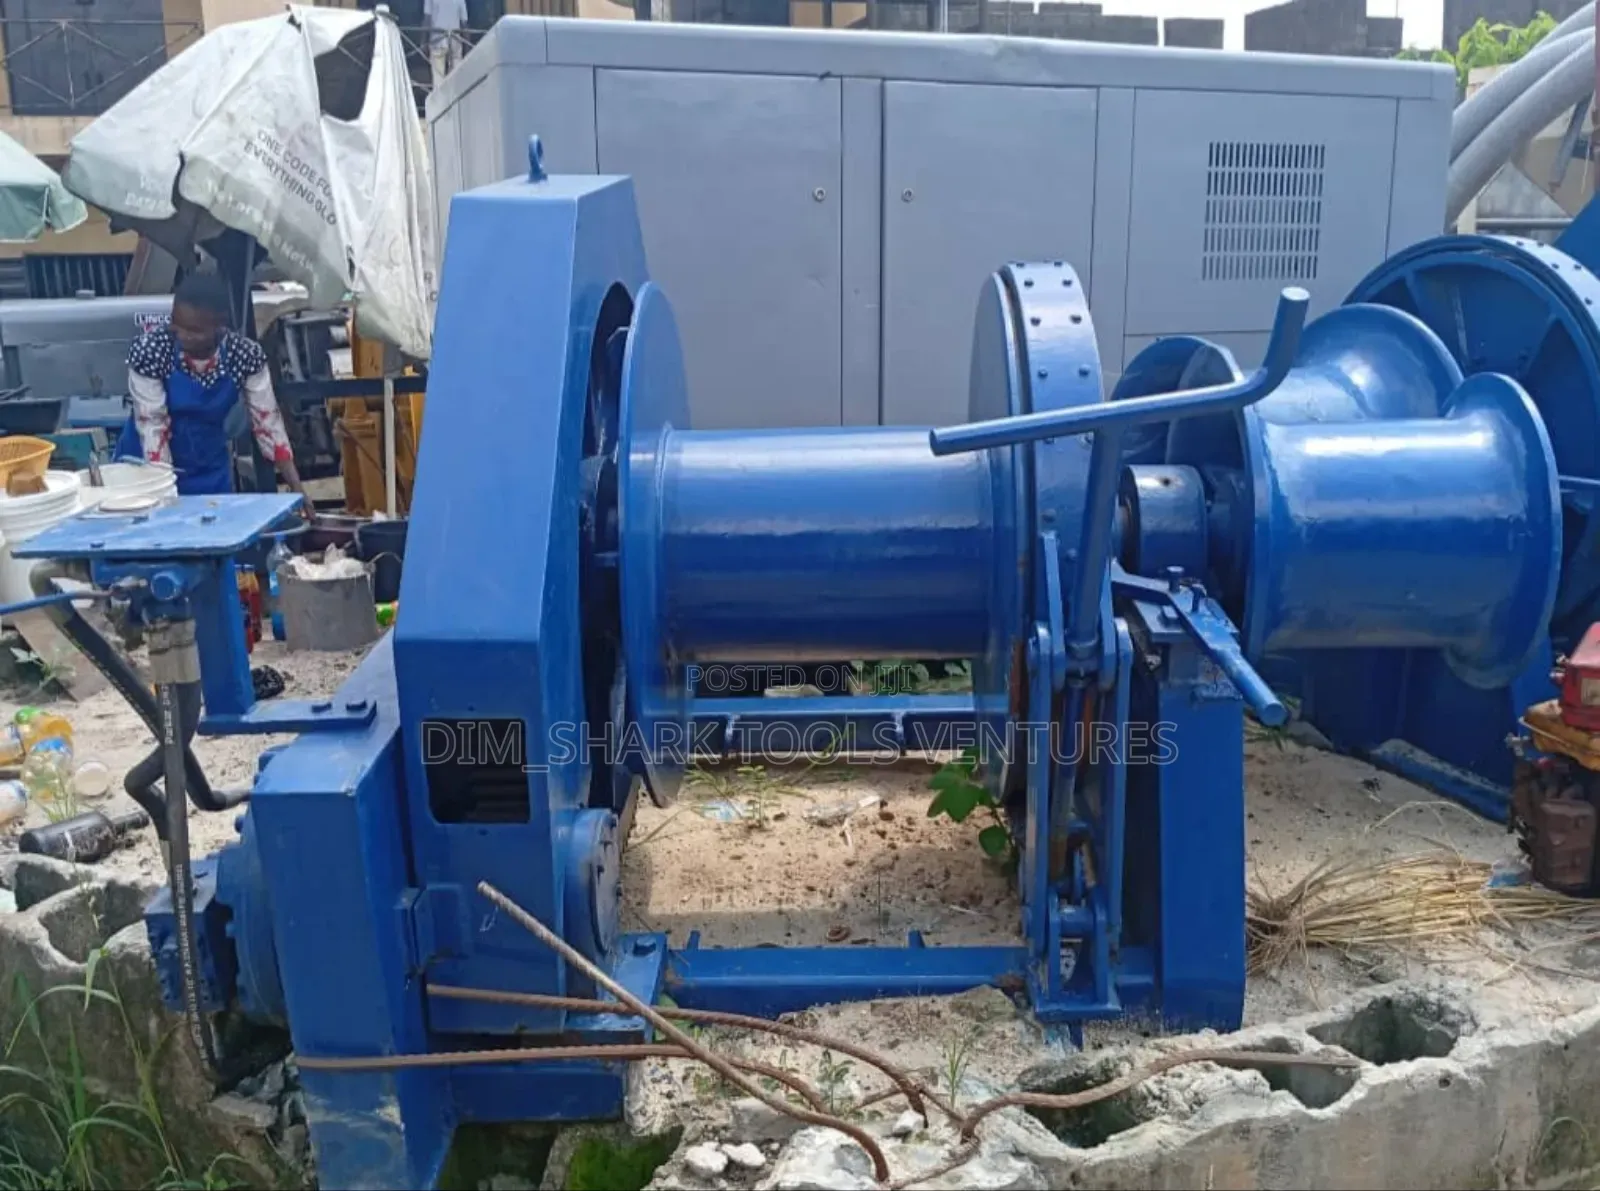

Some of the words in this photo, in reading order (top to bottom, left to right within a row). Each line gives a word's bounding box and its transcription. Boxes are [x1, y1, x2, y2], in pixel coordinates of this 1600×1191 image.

[243, 140, 316, 205] EVERYTHING
[257, 128, 284, 157] ONE
[283, 150, 317, 184] CODE
[316, 177, 334, 201] FO
